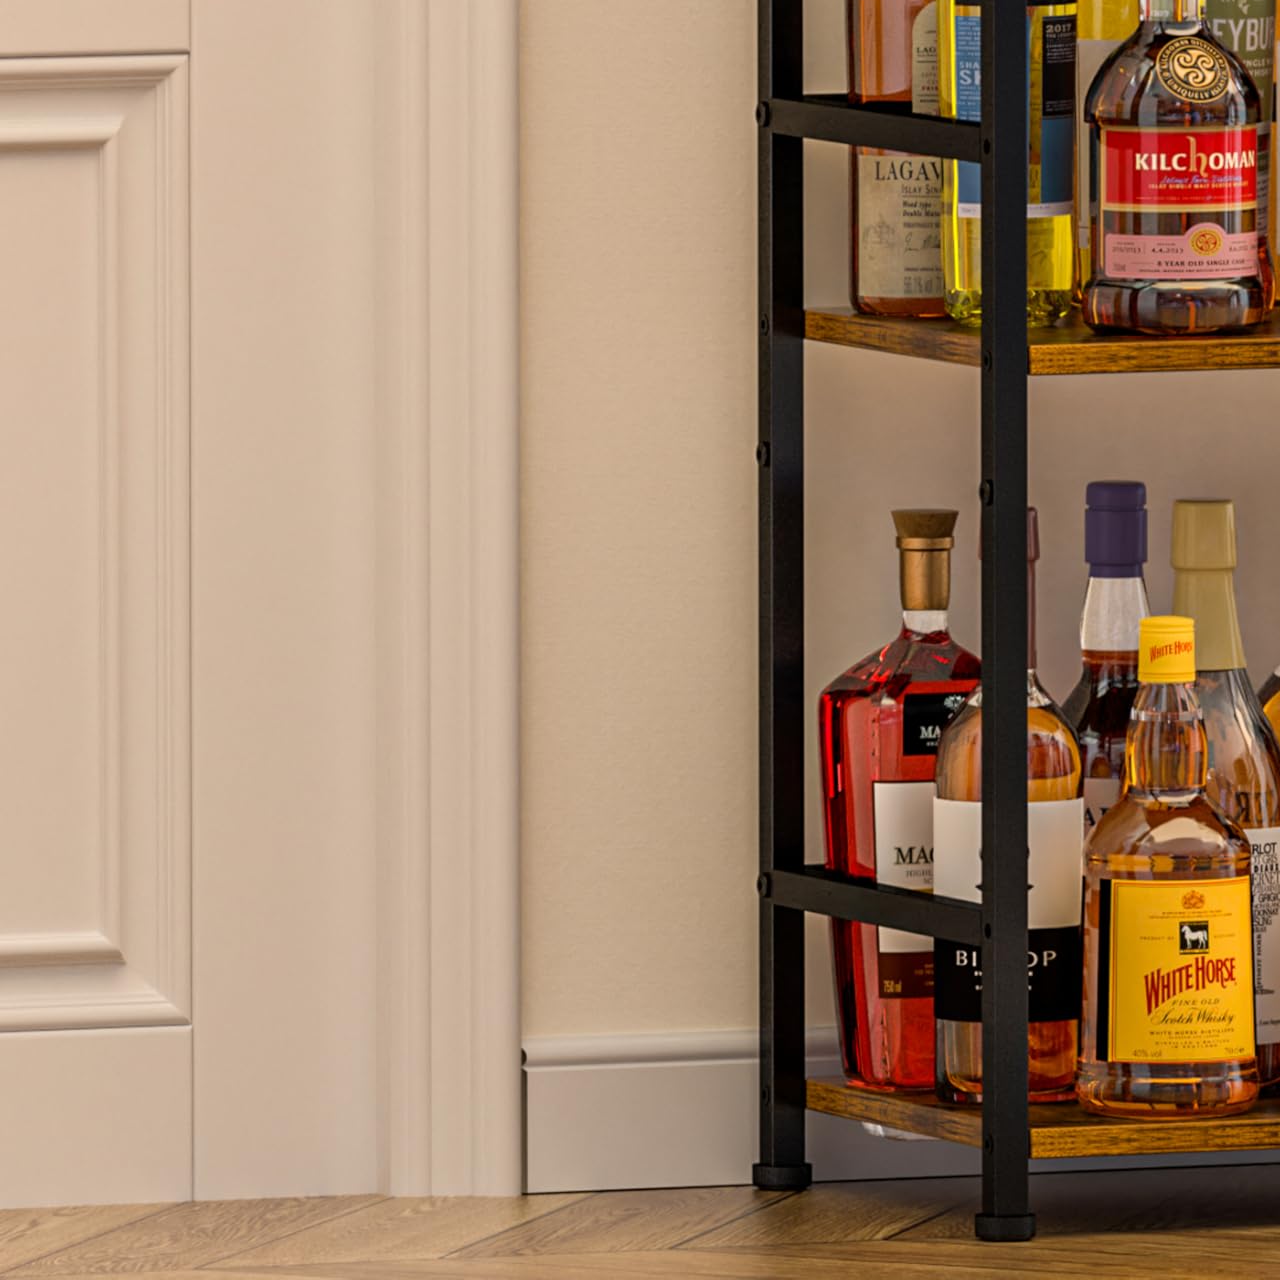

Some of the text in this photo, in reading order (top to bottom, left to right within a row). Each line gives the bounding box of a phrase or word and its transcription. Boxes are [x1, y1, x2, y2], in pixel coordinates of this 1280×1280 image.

[1046, 23, 1072, 33] 2017
[901, 184, 923, 194] ISLAY
[1151, 645, 1173, 663] WHITE
[956, 950, 1057, 967] BIOP
[1144, 964, 1194, 1016] WHITE
[1195, 956, 1236, 990] HORSE
[1151, 1007, 1234, 1025] Scotch Whisky
